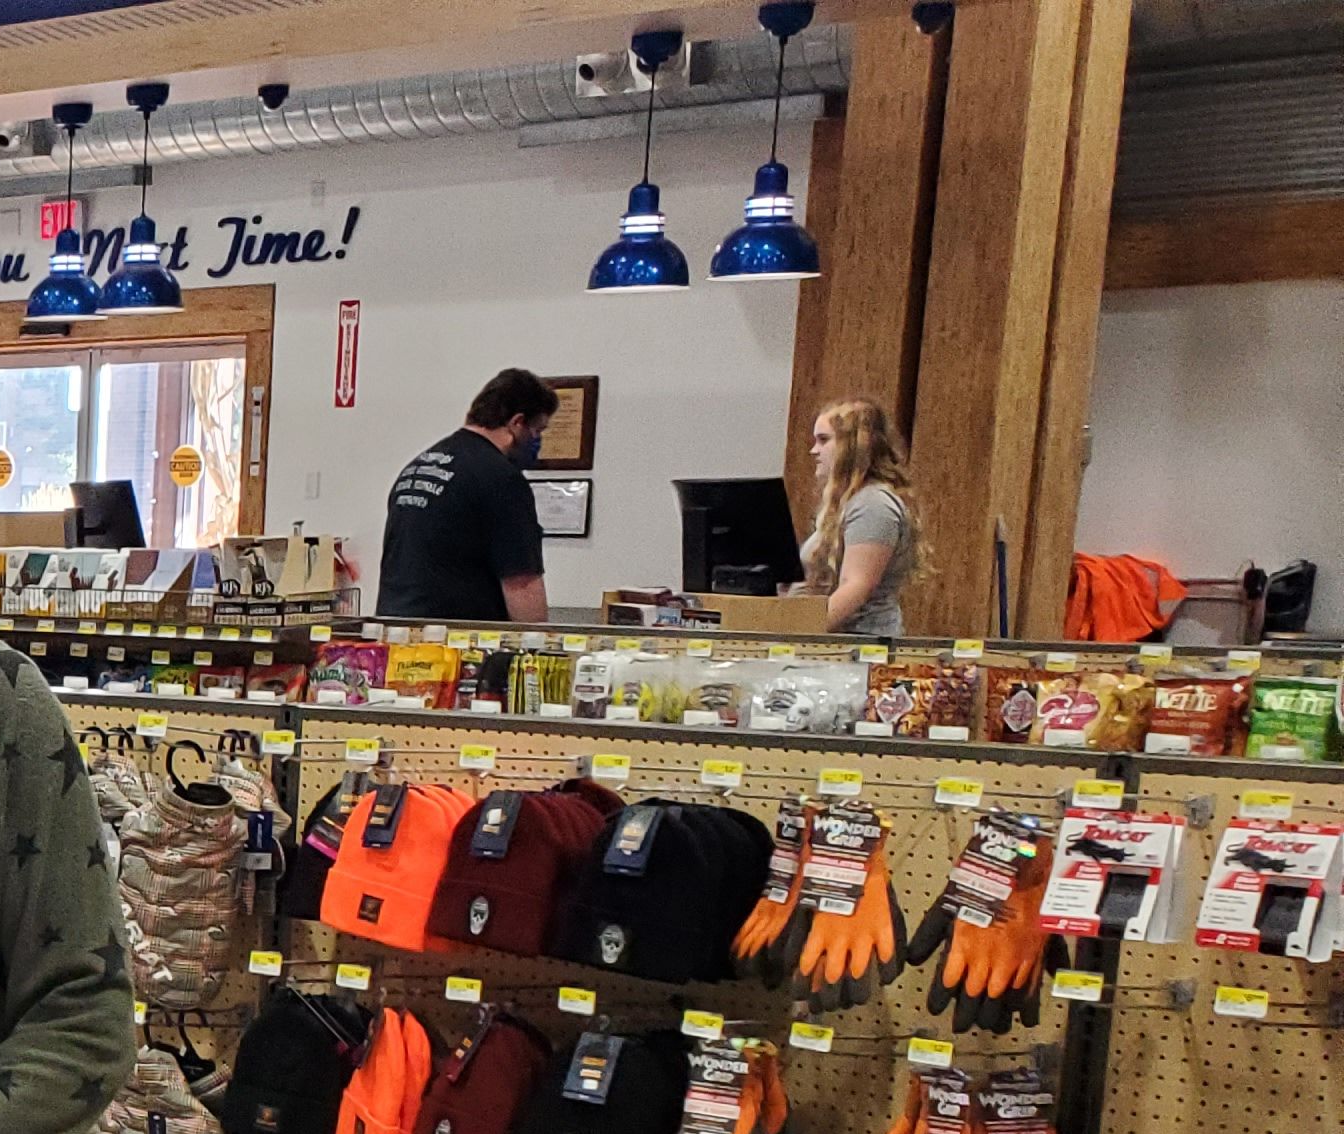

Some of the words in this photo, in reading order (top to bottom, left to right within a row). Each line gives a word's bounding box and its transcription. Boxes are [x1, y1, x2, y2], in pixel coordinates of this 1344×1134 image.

[207, 205, 361, 279] Time!
[813, 815, 882, 838] WONDER
[974, 820, 1024, 850] WOND
[1083, 824, 1153, 843] TOMCAT
[1246, 835, 1318, 854] TOMCAT
[687, 1053, 749, 1074] WONDER
